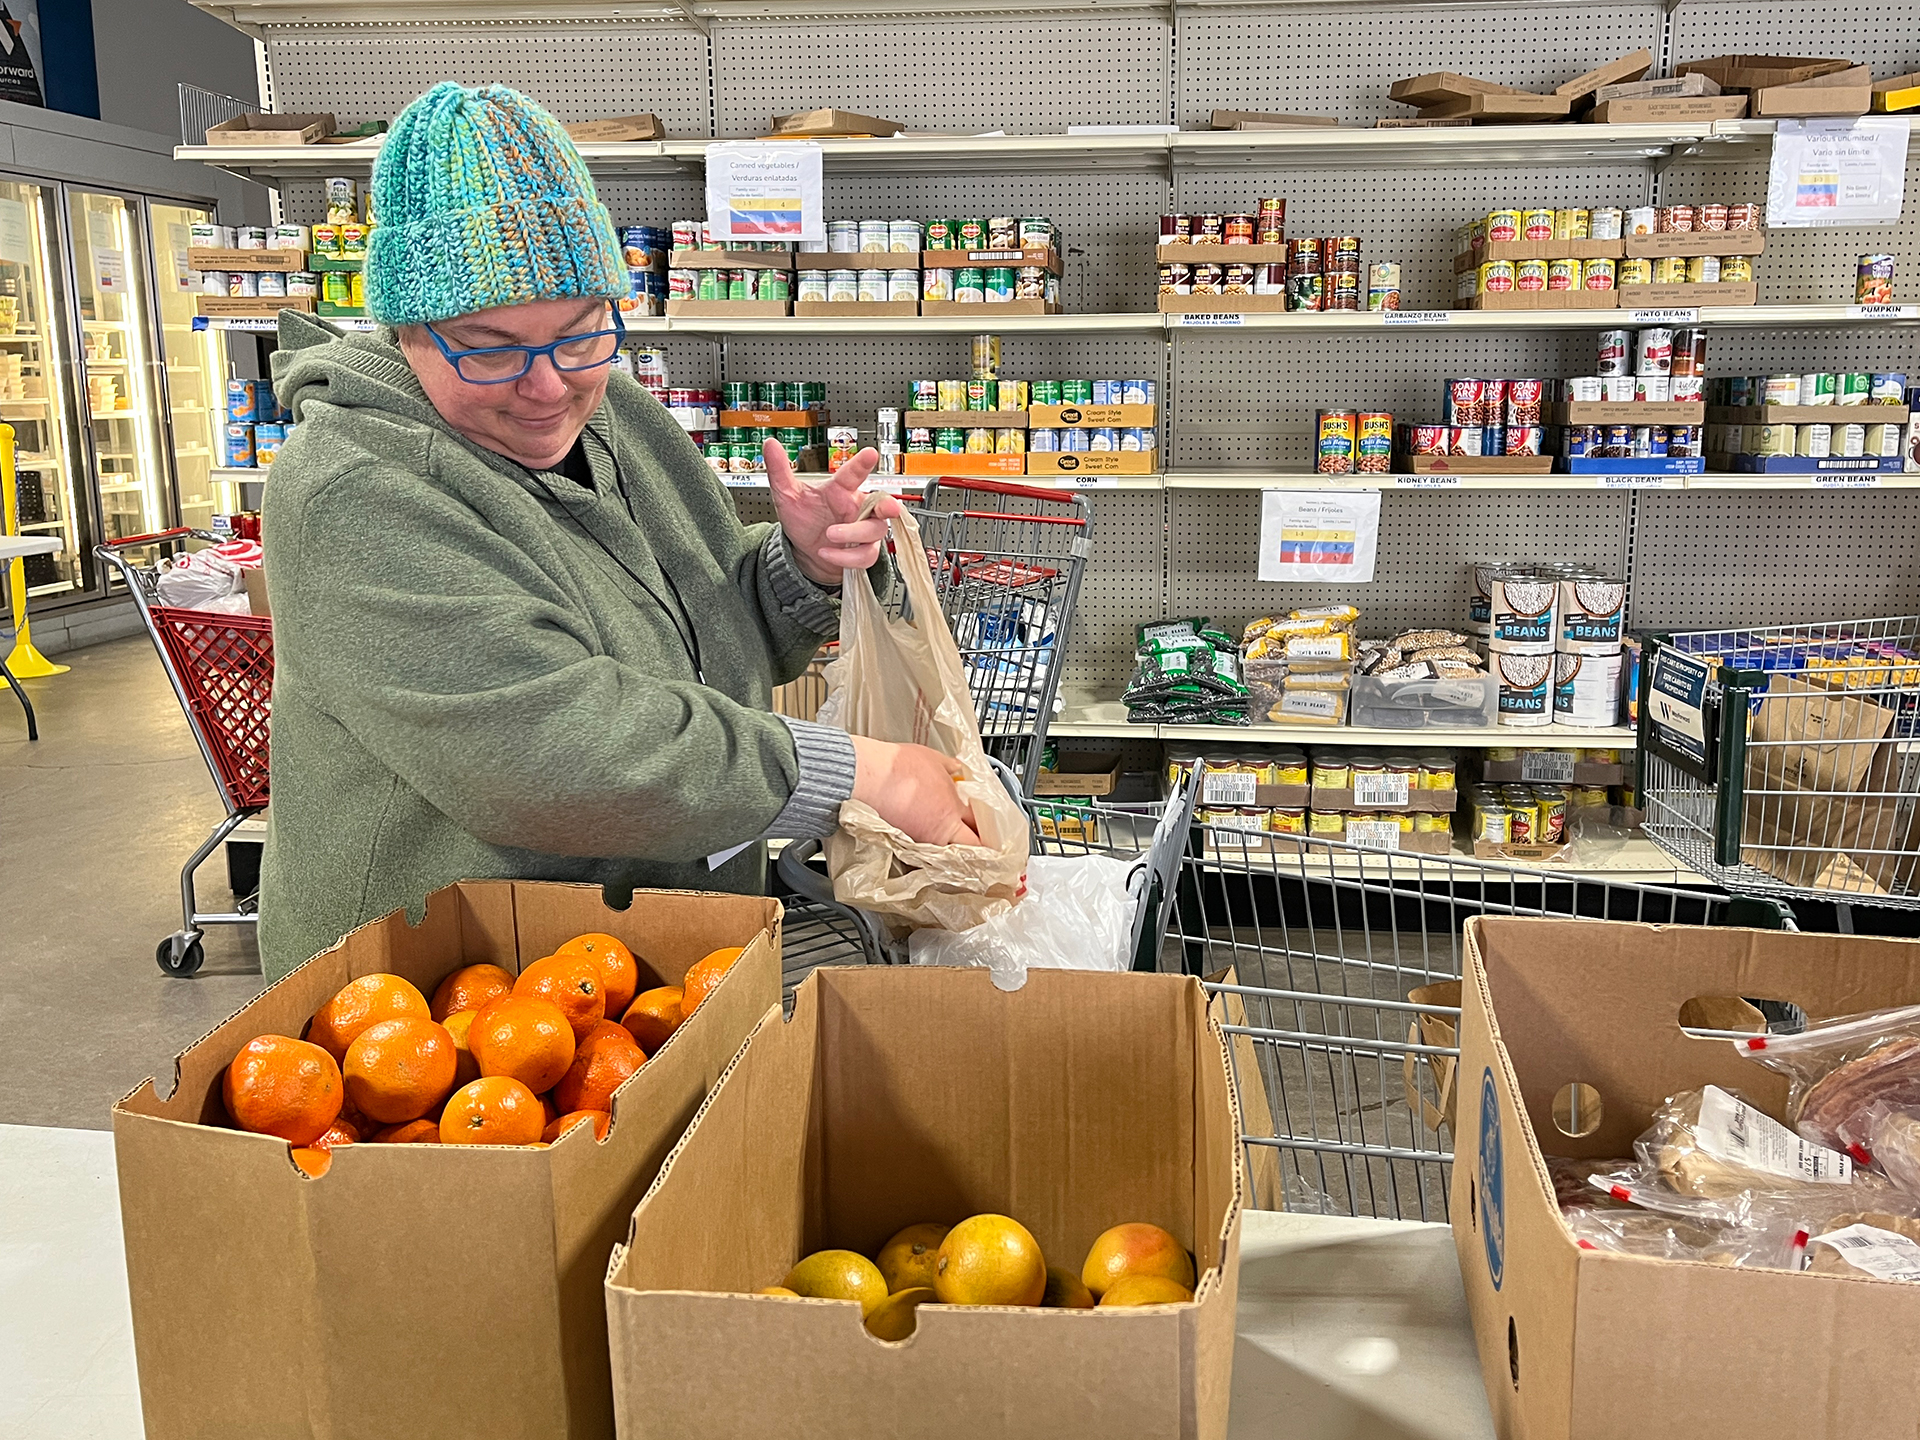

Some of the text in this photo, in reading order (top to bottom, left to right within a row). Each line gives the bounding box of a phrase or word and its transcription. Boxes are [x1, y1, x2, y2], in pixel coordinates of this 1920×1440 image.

[729, 161, 755, 169] Canned
[731, 174, 763, 182] Verduras
[1491, 218, 1515, 227] LUCK'S
[1527, 218, 1551, 227] LUCK'S
[1487, 269, 1511, 278] LUCK'S
[1519, 268, 1542, 278] LUCK'S
[1550, 268, 1569, 277] UCK'S
[1588, 268, 1613, 277] LUCK'S
[1454, 382, 1478, 391] JOAN
[1513, 382, 1537, 391] JOAN
[1323, 421, 1348, 430] BUSH'S
[1364, 421, 1389, 430] BUSH'S
[1475, 608, 1491, 617] BEA
[1505, 626, 1547, 637] BEANS
[1575, 626, 1617, 638] BEANS
[1500, 697, 1542, 709] BEANS
